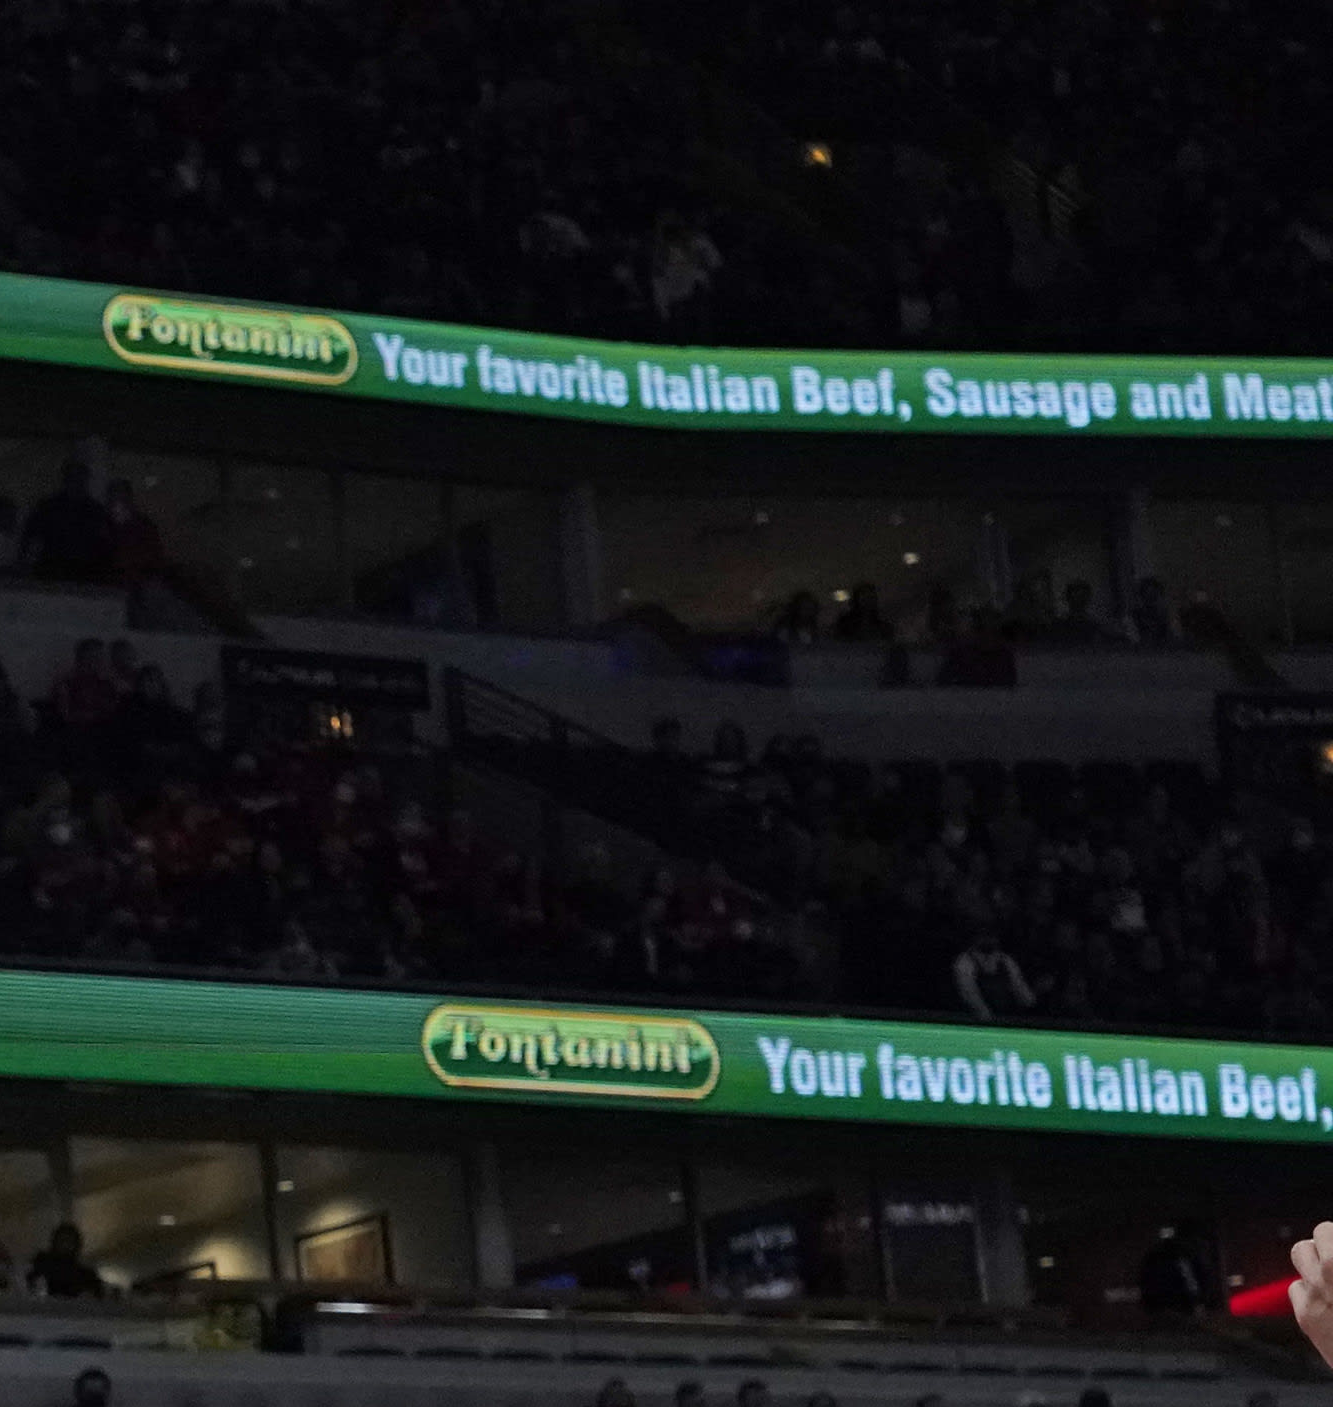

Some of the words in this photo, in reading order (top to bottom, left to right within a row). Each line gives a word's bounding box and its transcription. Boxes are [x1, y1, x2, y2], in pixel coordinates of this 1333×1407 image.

[120, 302, 337, 363] Fontanini
[371, 331, 468, 388] Your
[475, 343, 630, 408] favorite
[636, 359, 781, 414] Italian
[790, 364, 913, 423] Beef,
[923, 367, 1118, 429] Sausage
[1128, 372, 1213, 421] and
[444, 1014, 693, 1080] Fontanini
[757, 1034, 868, 1098] Your
[876, 1042, 1053, 1110] favorite
[1063, 1053, 1209, 1118] Italian
[1217, 1062, 1332, 1133] Beef,
